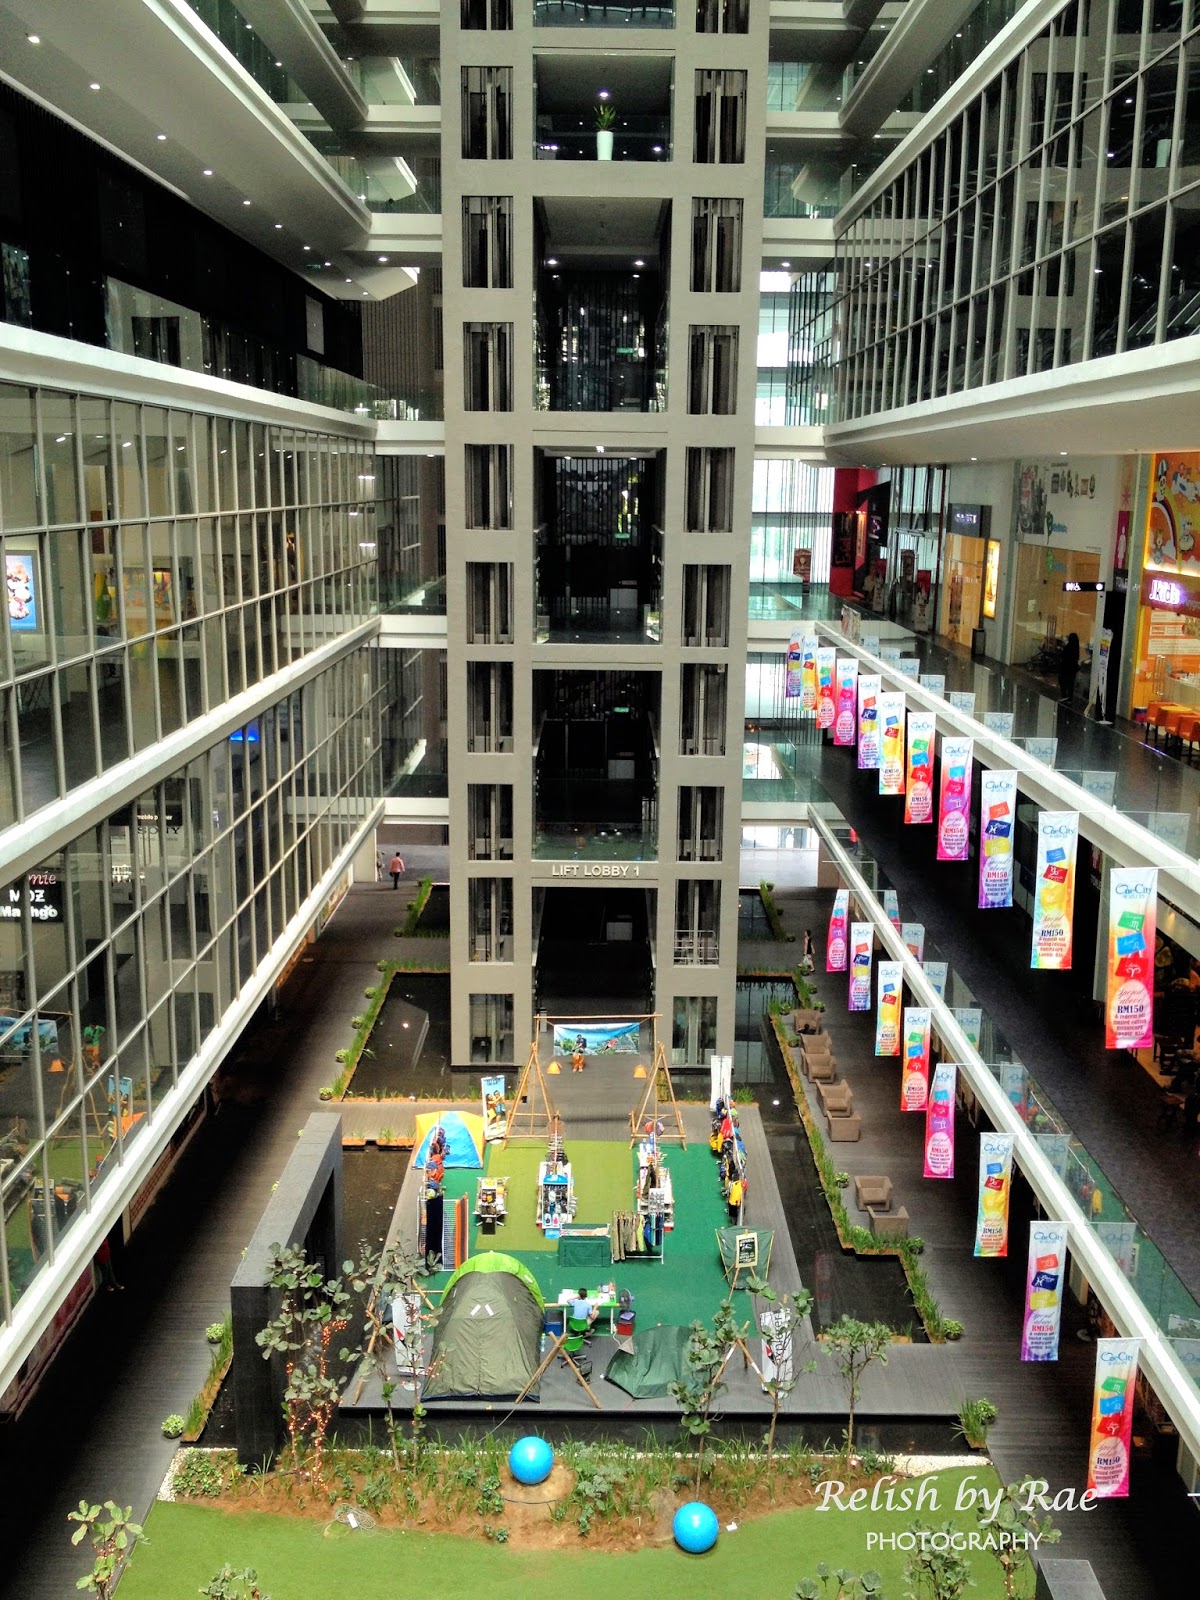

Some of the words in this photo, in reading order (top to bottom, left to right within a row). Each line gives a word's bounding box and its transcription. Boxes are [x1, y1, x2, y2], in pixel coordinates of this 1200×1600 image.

[138, 826, 180, 835] SOY
[552, 864, 579, 876] LIFT
[584, 865, 629, 877] LOBBY
[634, 866, 640, 877] 1
[1041, 929, 1064, 937] RM150
[1117, 1005, 1144, 1014] RM150
[1097, 1456, 1121, 1465] RM150
